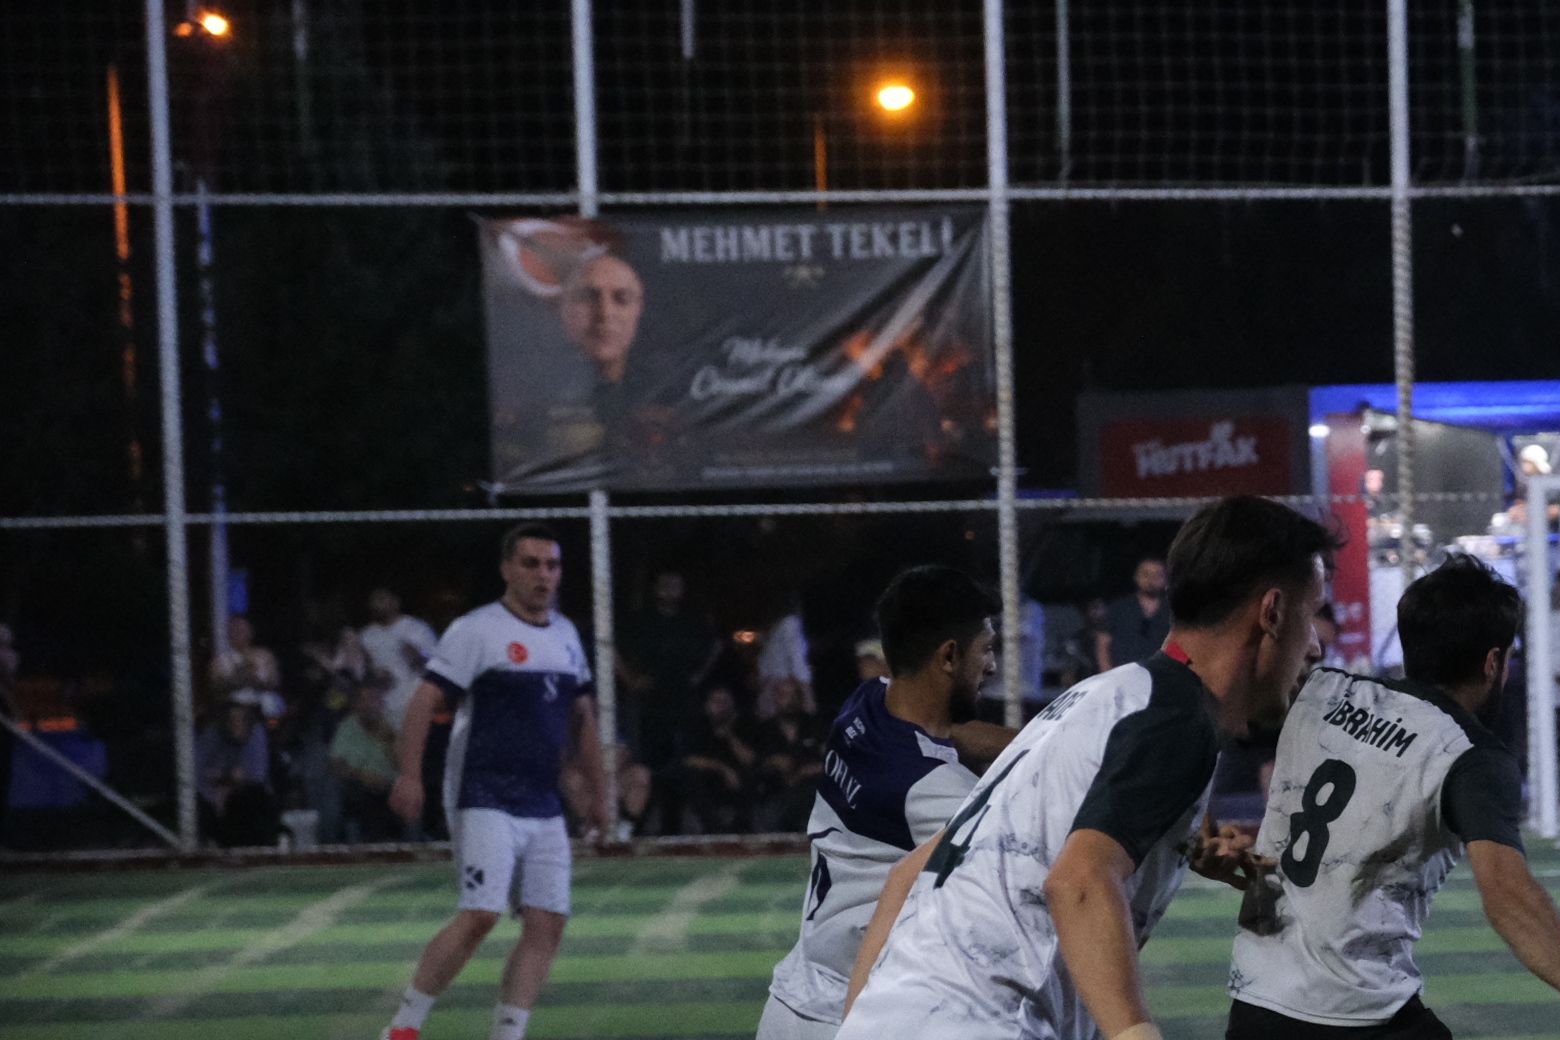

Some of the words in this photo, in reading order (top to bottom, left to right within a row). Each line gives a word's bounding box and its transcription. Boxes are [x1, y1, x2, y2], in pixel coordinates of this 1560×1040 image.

[660, 224, 815, 263] MEHMET
[1322, 693, 1419, 758] İBRAHİM
[921, 748, 1032, 889] 4
[1280, 757, 1358, 889] 8
